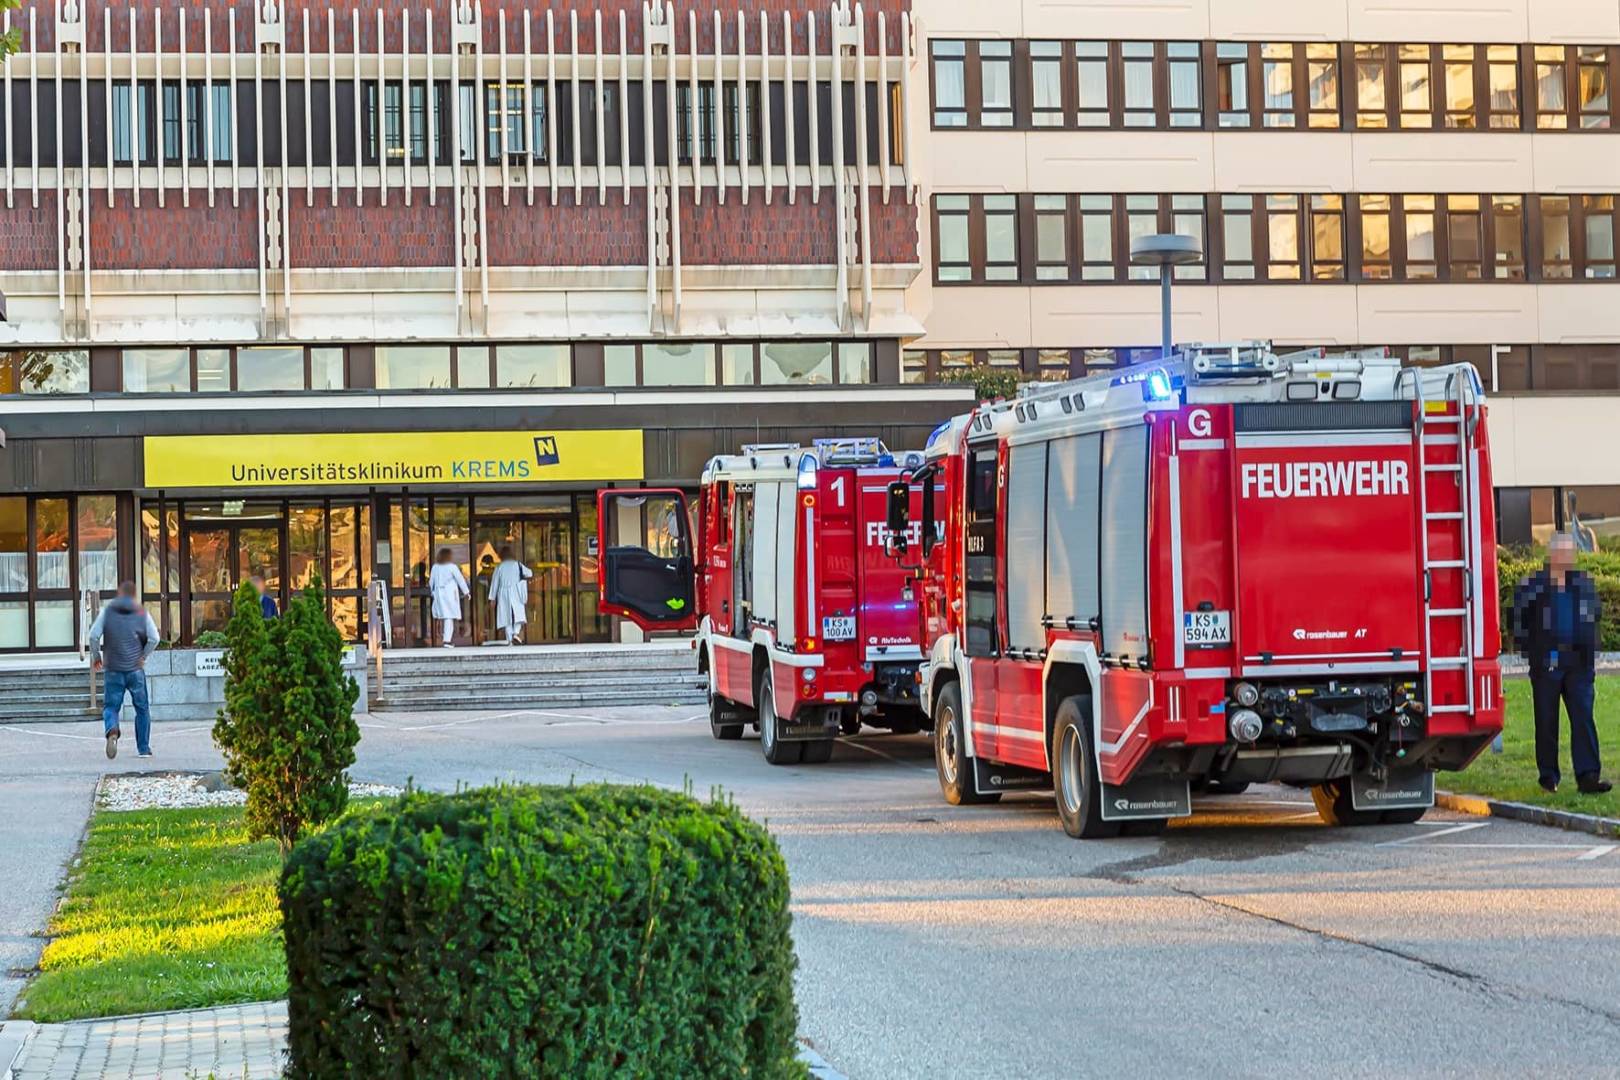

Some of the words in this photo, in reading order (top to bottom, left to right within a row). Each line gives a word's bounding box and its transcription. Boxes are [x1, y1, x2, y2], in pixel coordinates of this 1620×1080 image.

[1188, 409, 1212, 437] G
[232, 462, 442, 481] Universitätsklinikum
[452, 460, 530, 478] KREMS
[1241, 460, 1409, 499] FEUERWEHR
[831, 476, 845, 507] 1
[832, 618, 843, 627] KS
[1195, 614, 1211, 627] KS
[826, 628, 841, 637] 100
[842, 627, 853, 636] AV
[1186, 628, 1208, 641] 594
[1211, 627, 1227, 640] AX
[1306, 630, 1348, 640] rosenbauer
[1129, 800, 1177, 810] rosenbauer
